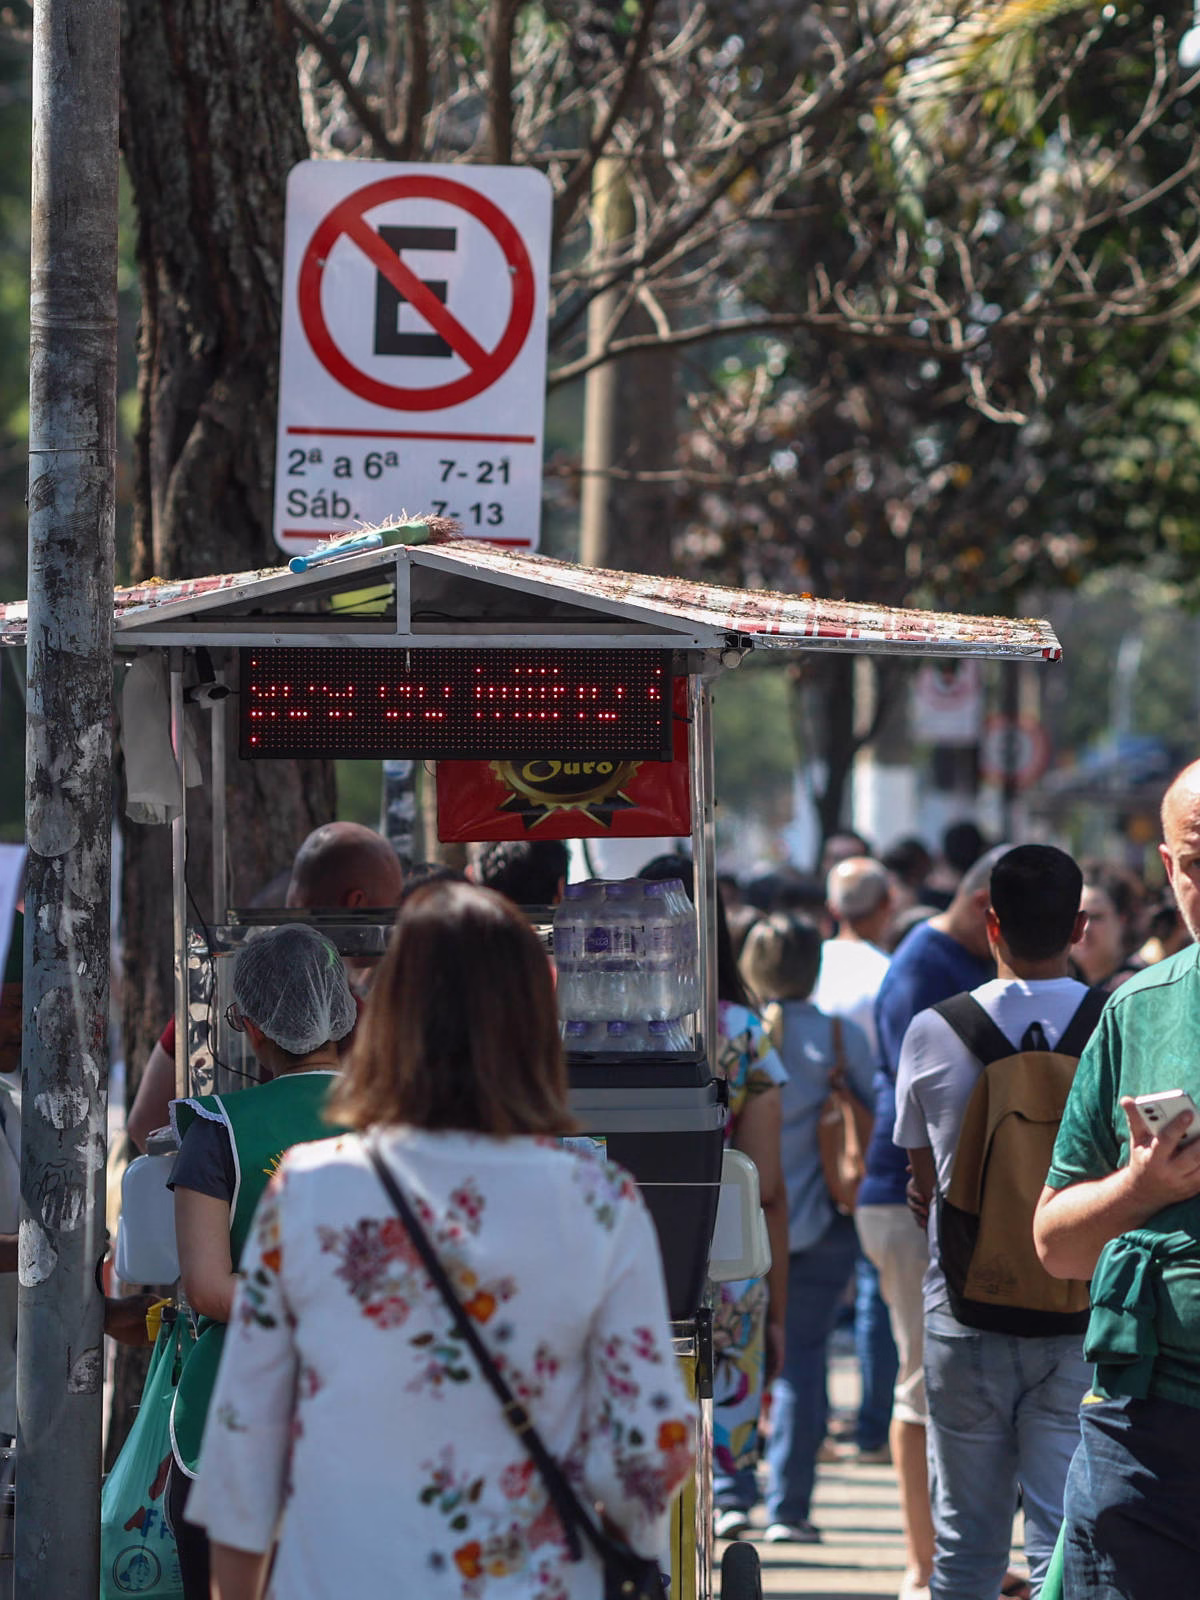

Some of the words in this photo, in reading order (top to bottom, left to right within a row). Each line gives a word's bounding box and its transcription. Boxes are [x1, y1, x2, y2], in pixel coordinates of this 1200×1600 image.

[373, 224, 457, 358] E
[333, 455, 352, 478] a
[286, 488, 361, 520] Sáb.
